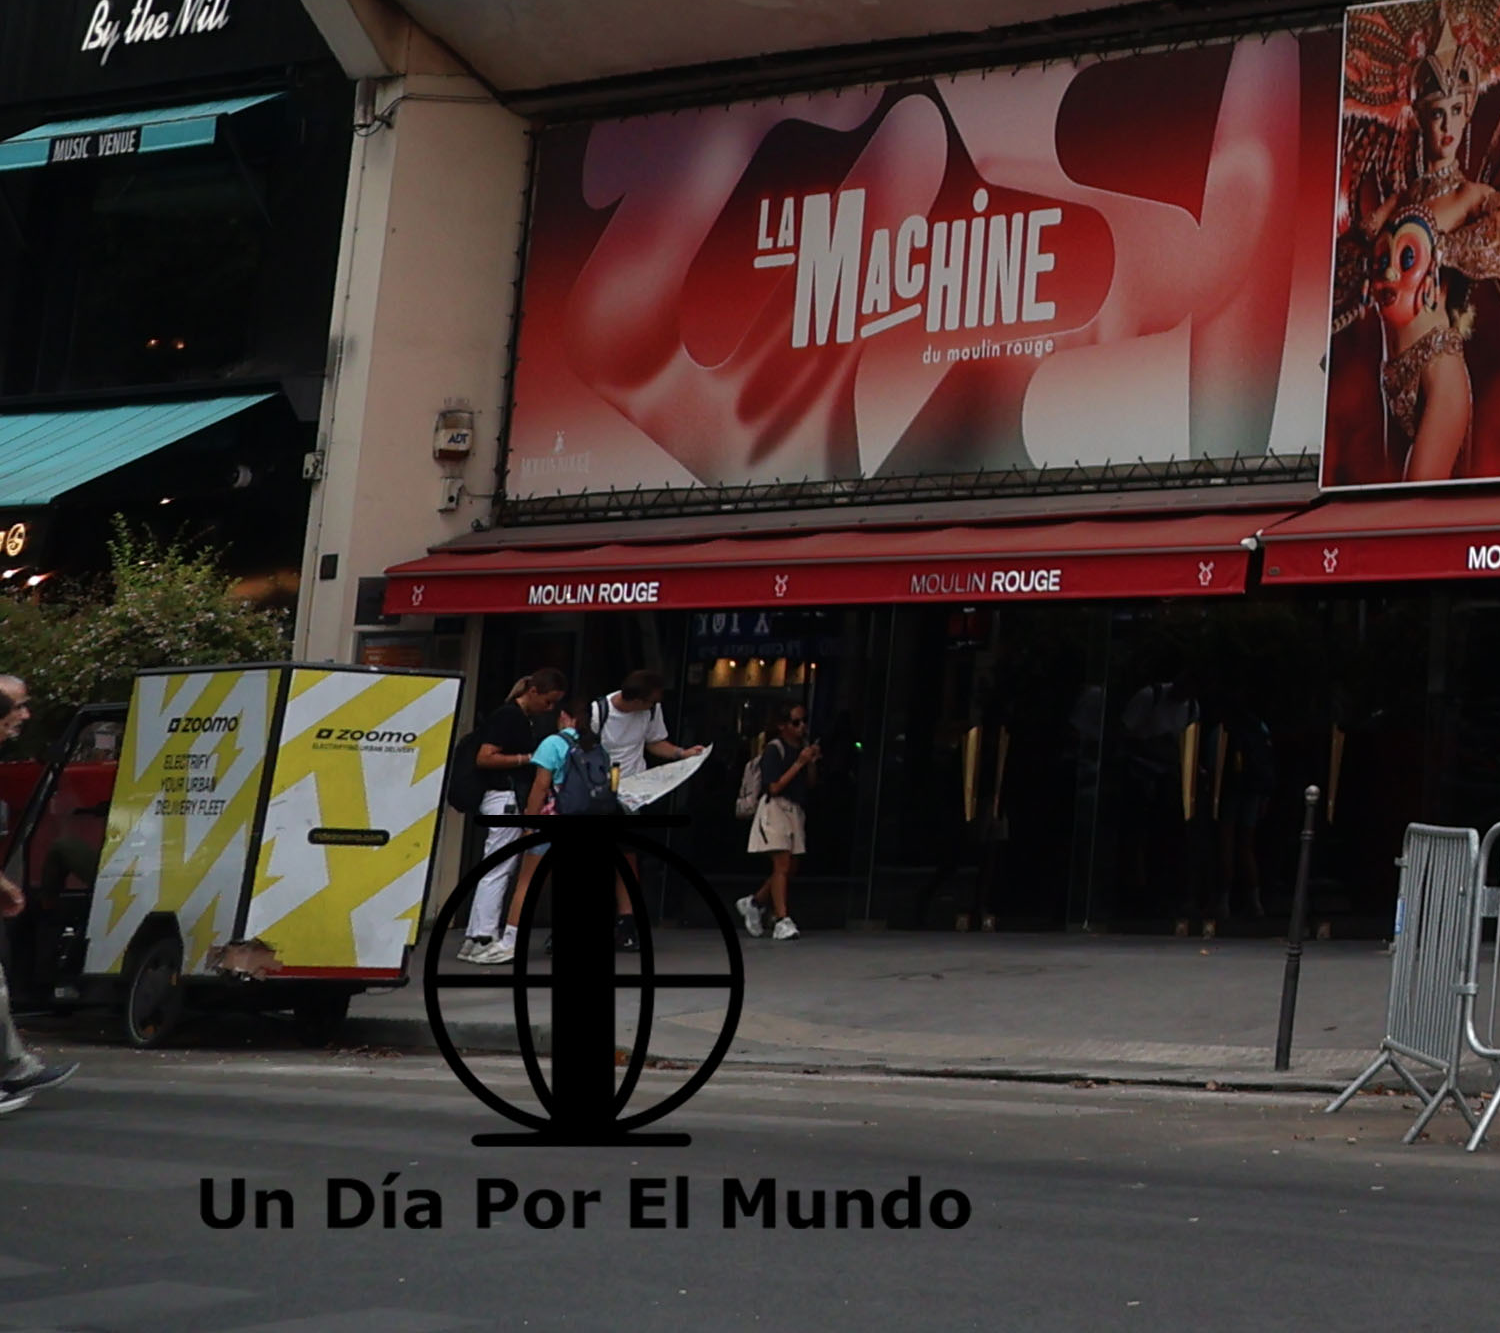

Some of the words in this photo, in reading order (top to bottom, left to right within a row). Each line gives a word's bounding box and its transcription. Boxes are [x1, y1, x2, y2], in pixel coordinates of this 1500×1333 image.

[53, 134, 92, 162] MUSIC
[98, 129, 138, 157] VENUE
[757, 197, 795, 254] LA
[922, 343, 943, 365] du
[947, 339, 1001, 361] moulin
[1006, 337, 1055, 363] rouge
[448, 433, 469, 444] ADT
[910, 571, 985, 596] MOULIN
[990, 568, 1062, 593] ROUGE
[528, 583, 594, 606] MOULIN
[597, 581, 660, 604] ROUGE
[181, 716, 239, 733] zoomo
[336, 729, 417, 744] zoomo
[163, 753, 211, 771] ELECTRIFY
[161, 777, 185, 793] YOUR
[185, 776, 218, 793] URBAN
[154, 799, 197, 816] DELIVERY
[197, 799, 227, 817] FLEET
